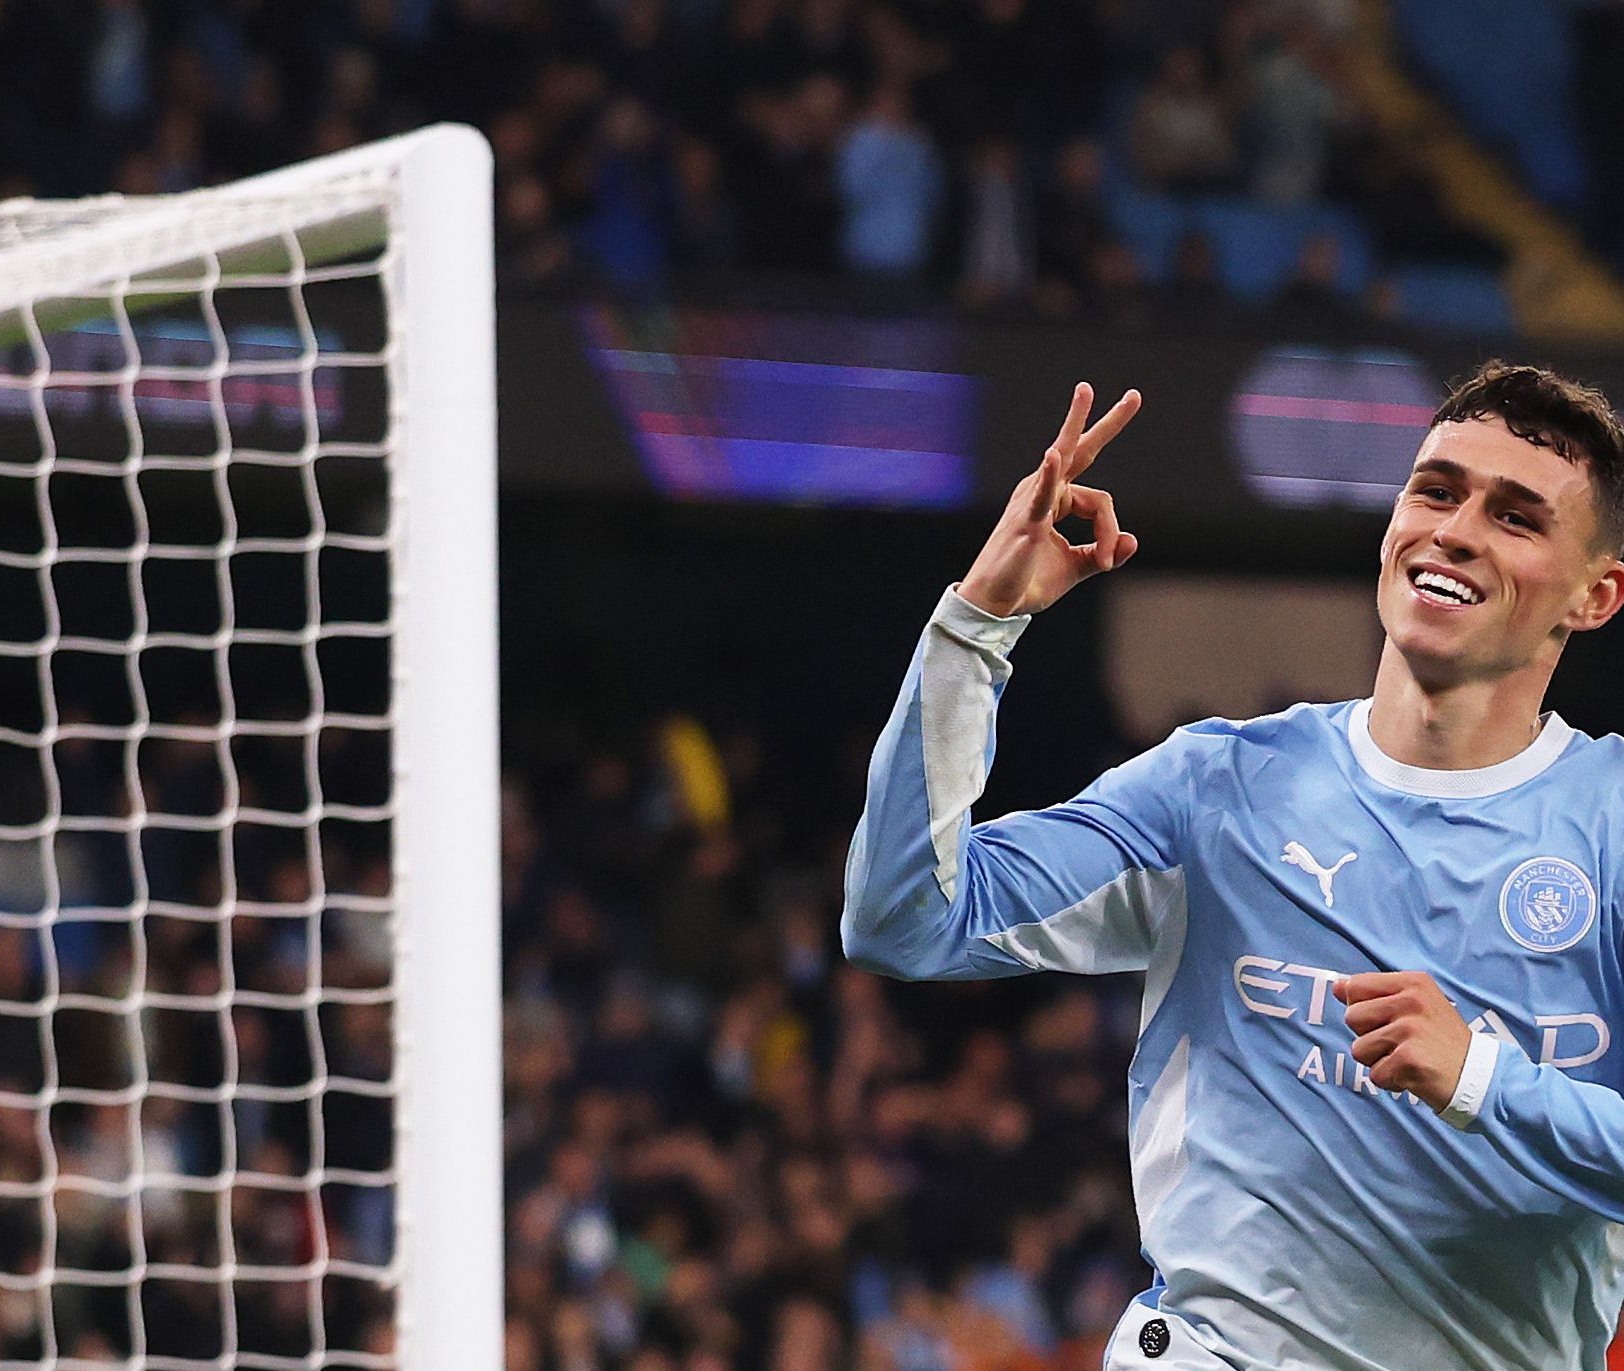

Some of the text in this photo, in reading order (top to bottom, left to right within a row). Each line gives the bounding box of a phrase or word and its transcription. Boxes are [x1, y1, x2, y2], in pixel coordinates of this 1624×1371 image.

[1513, 865, 1586, 897] MANCHESTER
[1530, 933, 1557, 944] CITY
[1233, 955, 1611, 1069] ETAD
